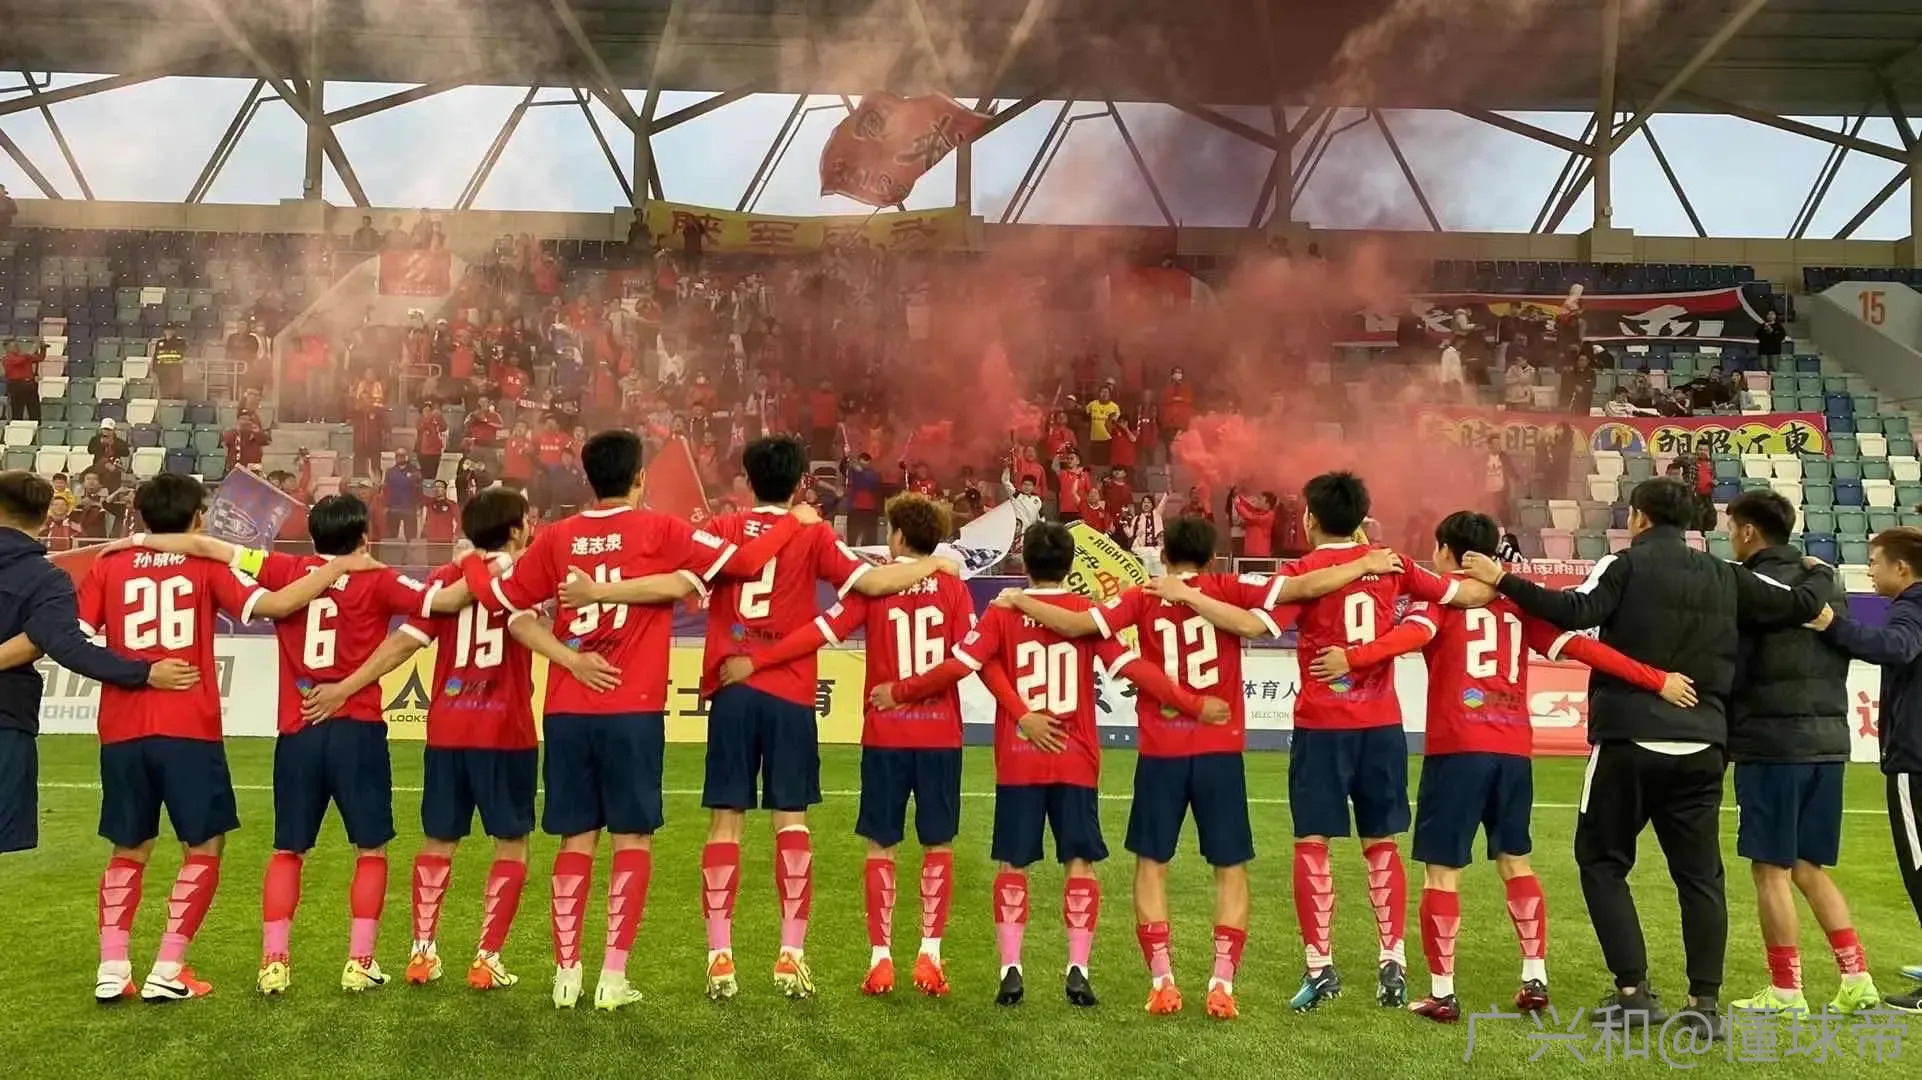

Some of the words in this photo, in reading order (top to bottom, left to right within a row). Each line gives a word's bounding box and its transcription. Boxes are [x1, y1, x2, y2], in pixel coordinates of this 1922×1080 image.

[1858, 290, 1886, 326] 15
[124, 574, 195, 651] 26
[738, 556, 777, 620] 2
[1344, 591, 1376, 650] 9
[303, 596, 338, 671] 6
[454, 602, 504, 669] 15
[888, 604, 945, 681] 16
[1154, 615, 1220, 690] 12
[1465, 607, 1523, 685] 21
[1016, 639, 1079, 716] 20
